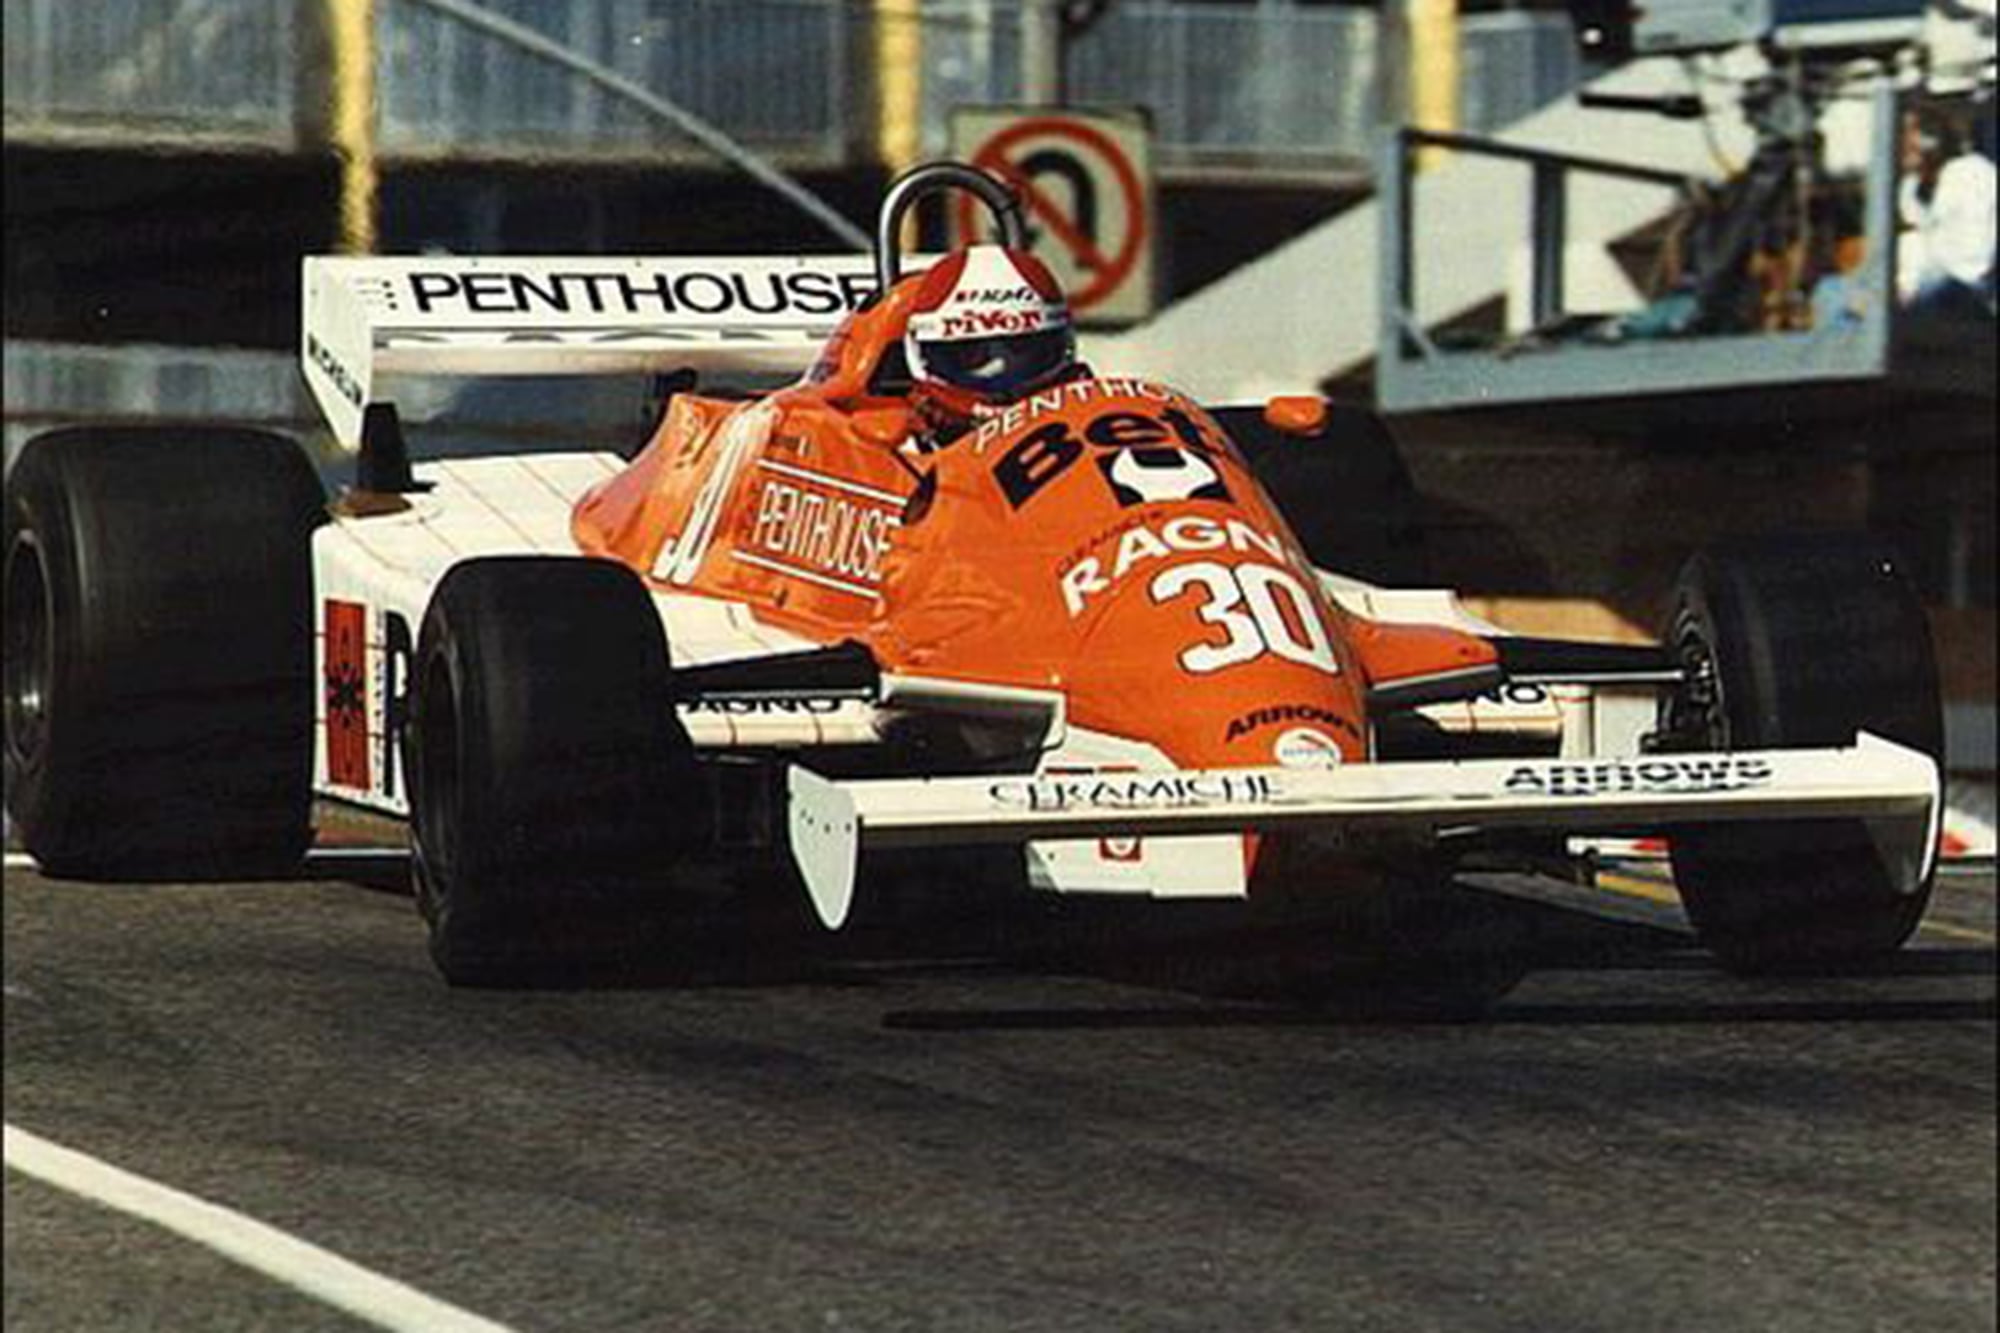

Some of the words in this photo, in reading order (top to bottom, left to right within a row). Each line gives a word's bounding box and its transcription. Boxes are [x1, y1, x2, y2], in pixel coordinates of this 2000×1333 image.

[405, 271, 877, 314] PENTHOUSE
[752, 482, 902, 582] PENTHOUSE
[1060, 515, 1298, 619] RAGN
[1148, 559, 1340, 676] 30
[1503, 759, 1773, 797] ARROWS
